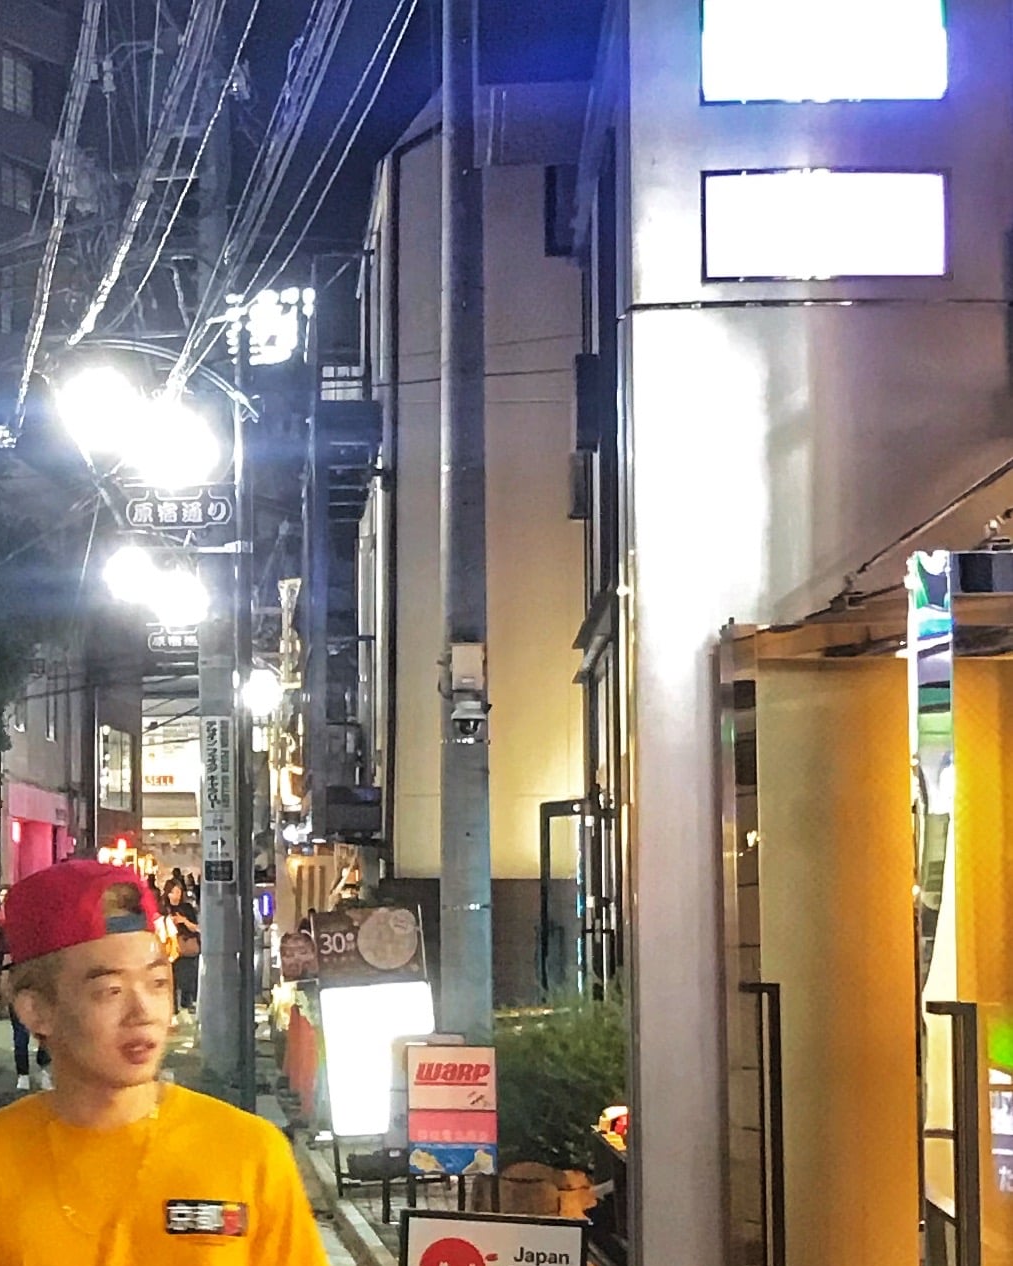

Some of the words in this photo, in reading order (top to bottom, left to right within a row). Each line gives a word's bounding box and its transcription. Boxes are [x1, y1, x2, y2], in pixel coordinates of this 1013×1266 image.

[133, 502, 226, 523] 原宿通り
[513, 1247, 570, 1266] Japan
